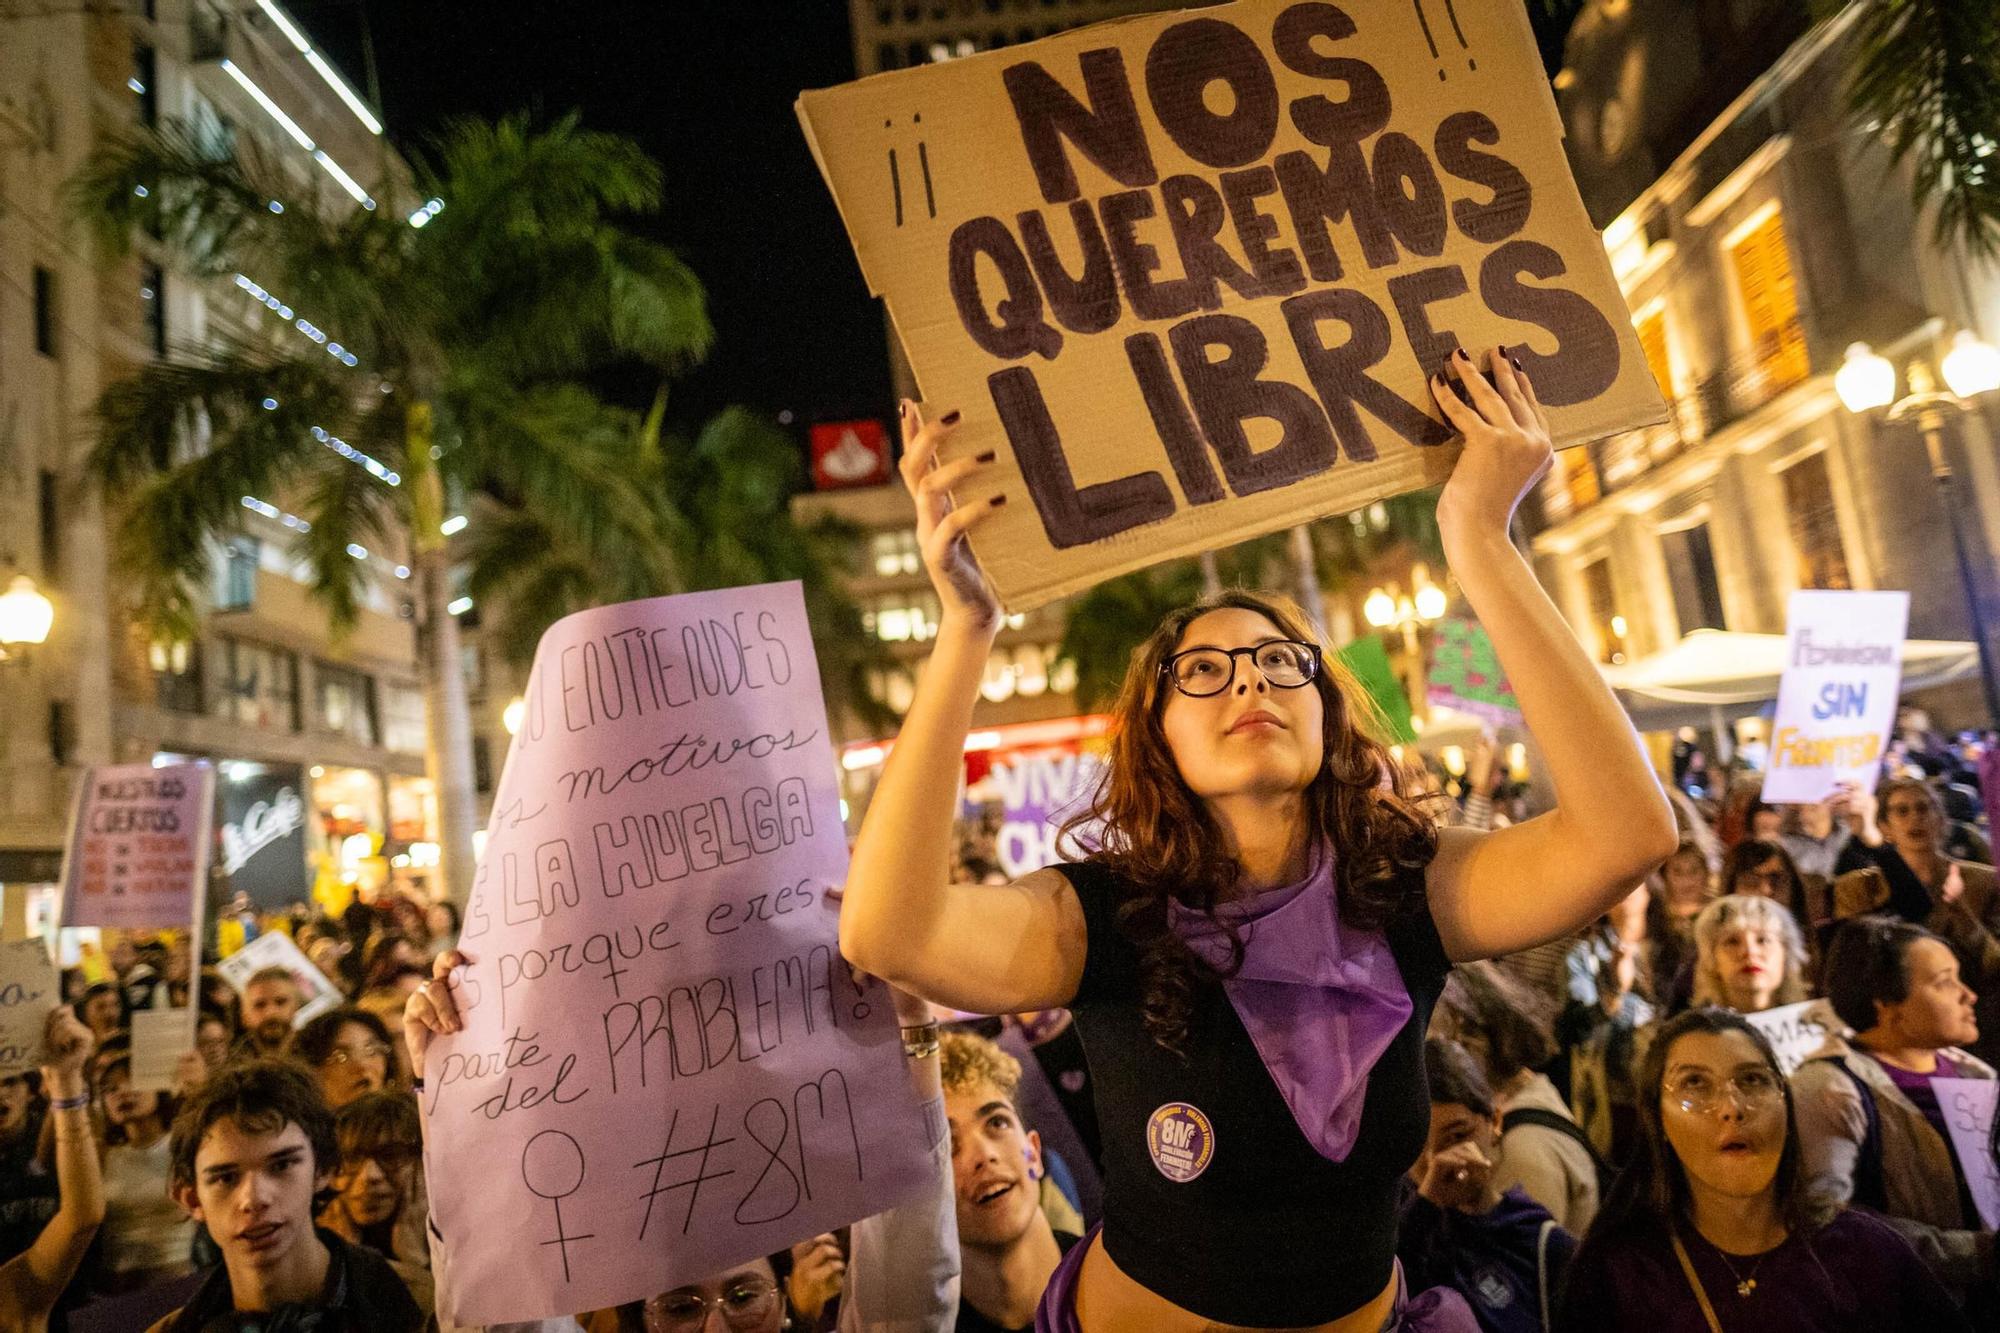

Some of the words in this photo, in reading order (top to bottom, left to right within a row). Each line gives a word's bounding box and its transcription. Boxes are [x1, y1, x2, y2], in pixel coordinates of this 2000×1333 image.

[1002, 1, 1390, 203] NOS
[948, 111, 1533, 360] QUEREMOS
[988, 240, 1620, 549] LIBRES
[562, 611, 792, 732] ENTIENDES
[1811, 682, 1868, 720] SIN
[557, 728, 820, 803] motivos
[502, 838, 580, 926] LA
[593, 777, 814, 898] HUELGA
[498, 922, 681, 1030] porque
[705, 878, 815, 936] eres
[427, 1027, 553, 1116] parte
[471, 1053, 590, 1120] del
[633, 1068, 863, 1241] #8M
